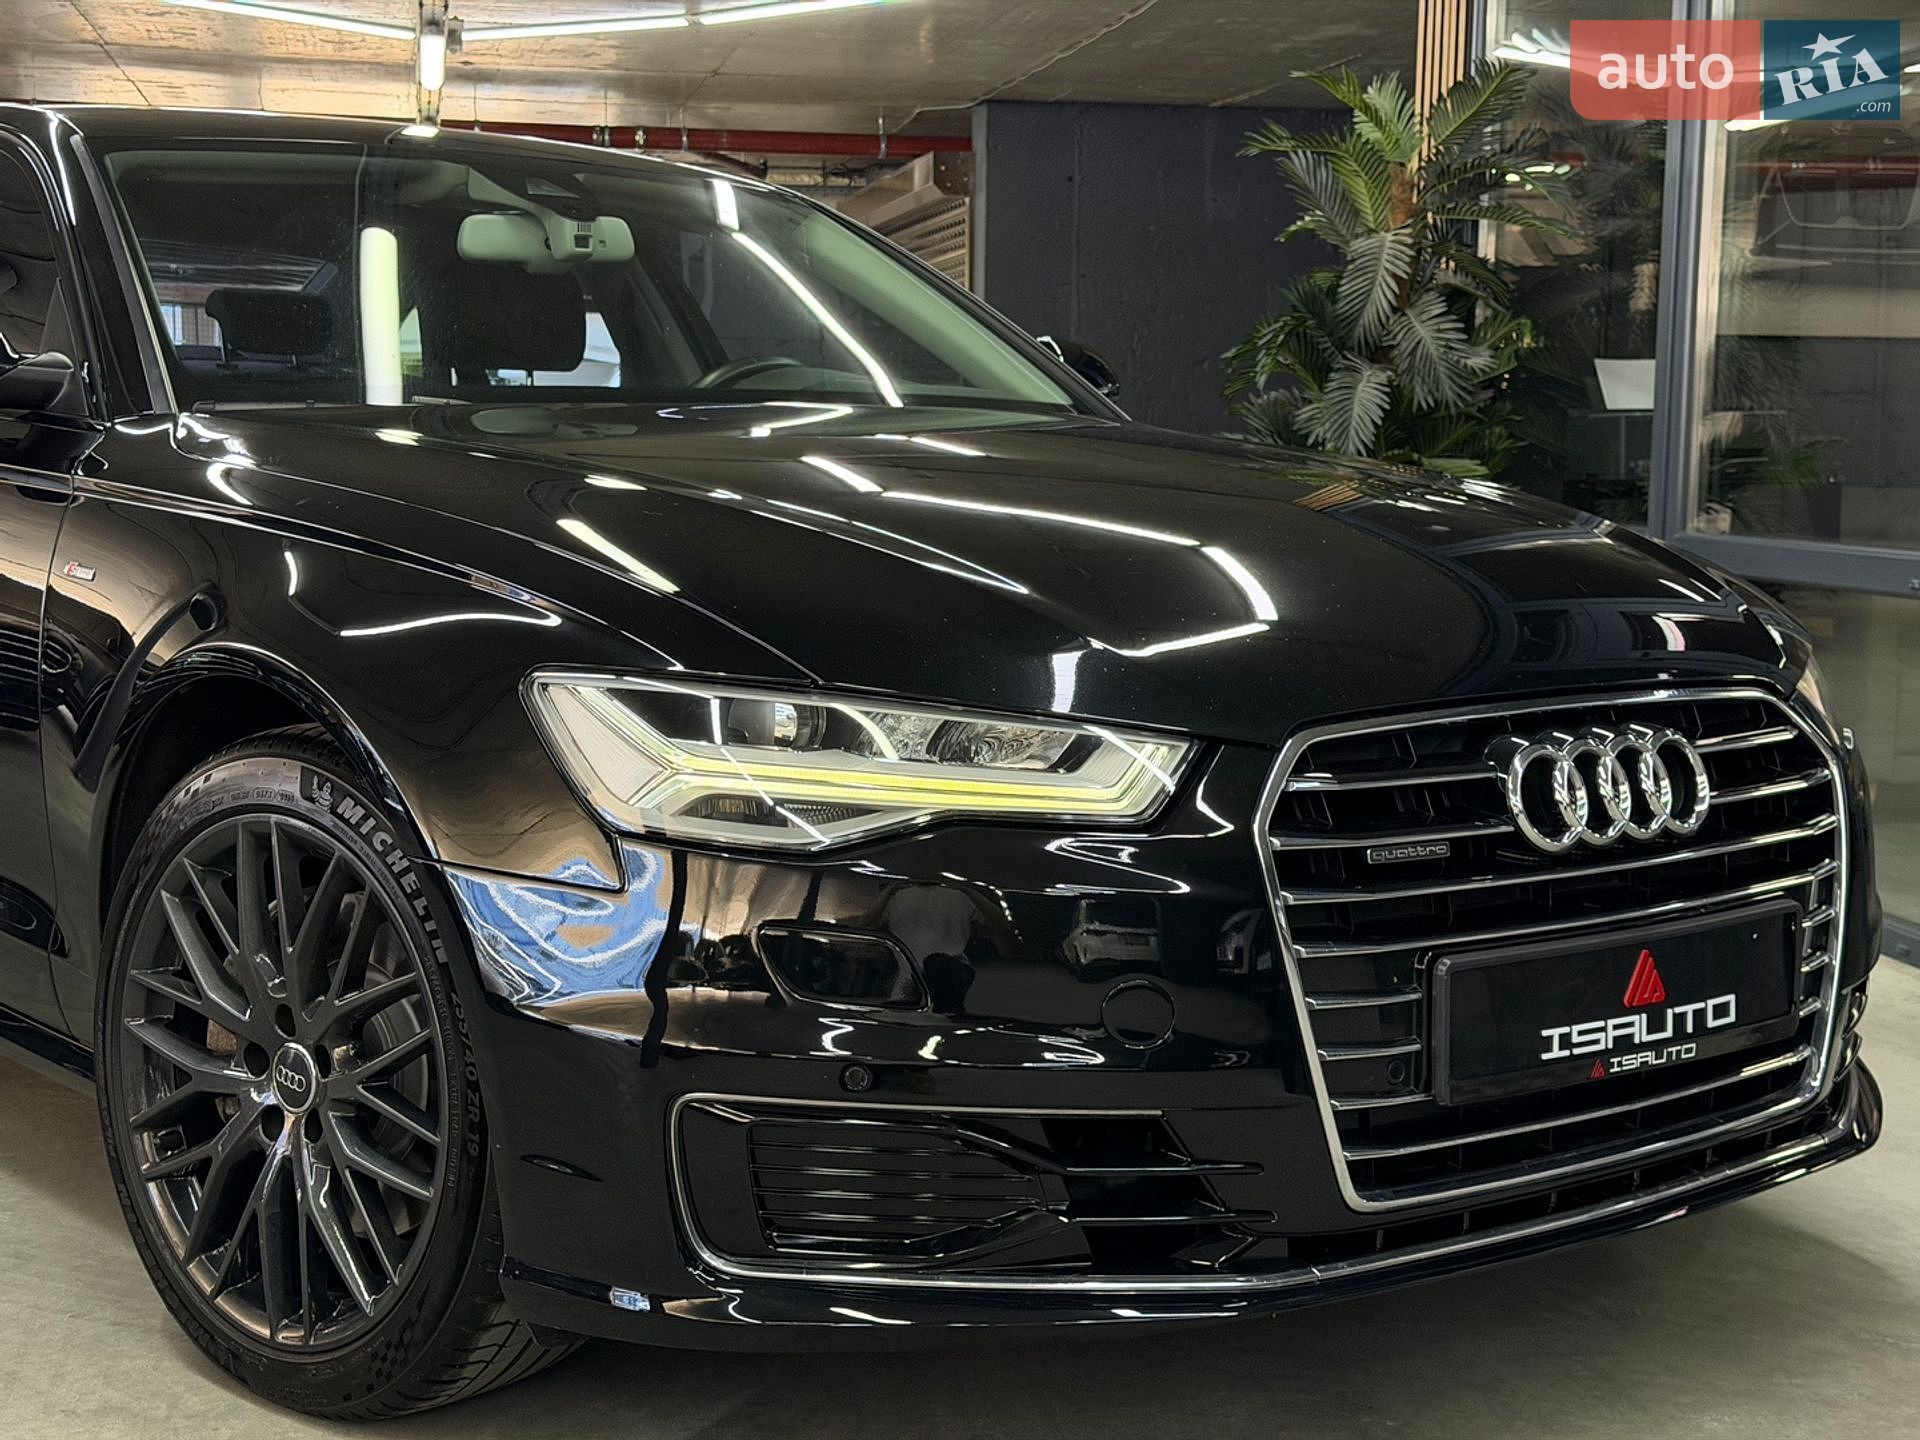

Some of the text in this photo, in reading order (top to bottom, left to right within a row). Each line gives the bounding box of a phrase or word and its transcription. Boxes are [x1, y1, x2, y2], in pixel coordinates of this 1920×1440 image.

[1372, 845, 1447, 862] quattro
[1541, 993, 1737, 1060] ISAUTO
[1609, 1042, 1697, 1073] ISAUTO
